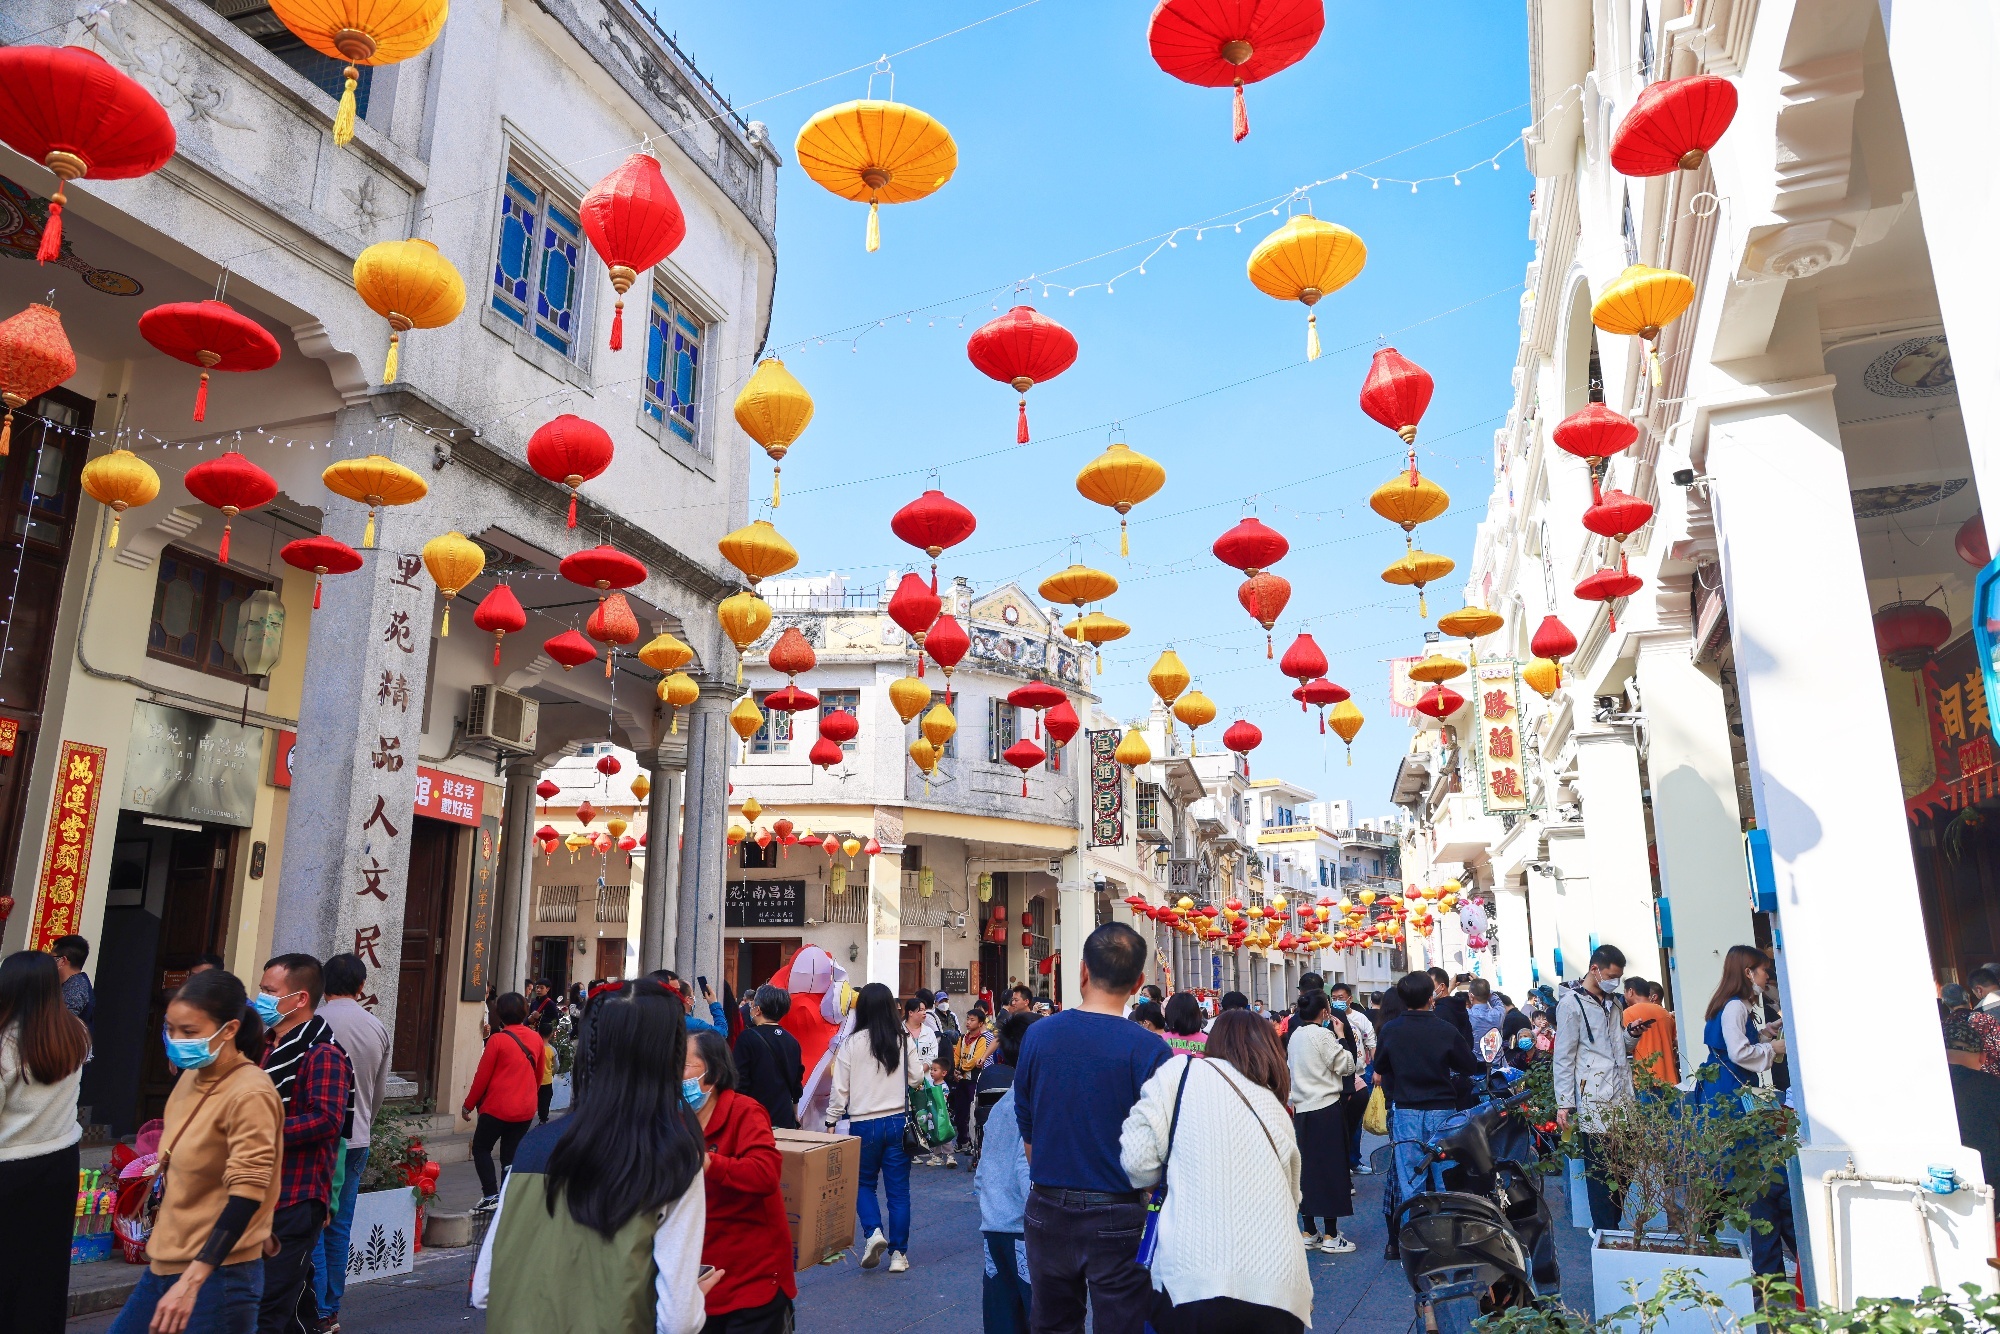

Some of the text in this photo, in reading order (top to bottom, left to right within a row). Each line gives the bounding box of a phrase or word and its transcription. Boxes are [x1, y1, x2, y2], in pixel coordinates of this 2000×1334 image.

[442, 778, 475, 800] 找名字
[440, 798, 474, 819] 戴好运
[726, 885, 796, 900] 苑·南昌盛
